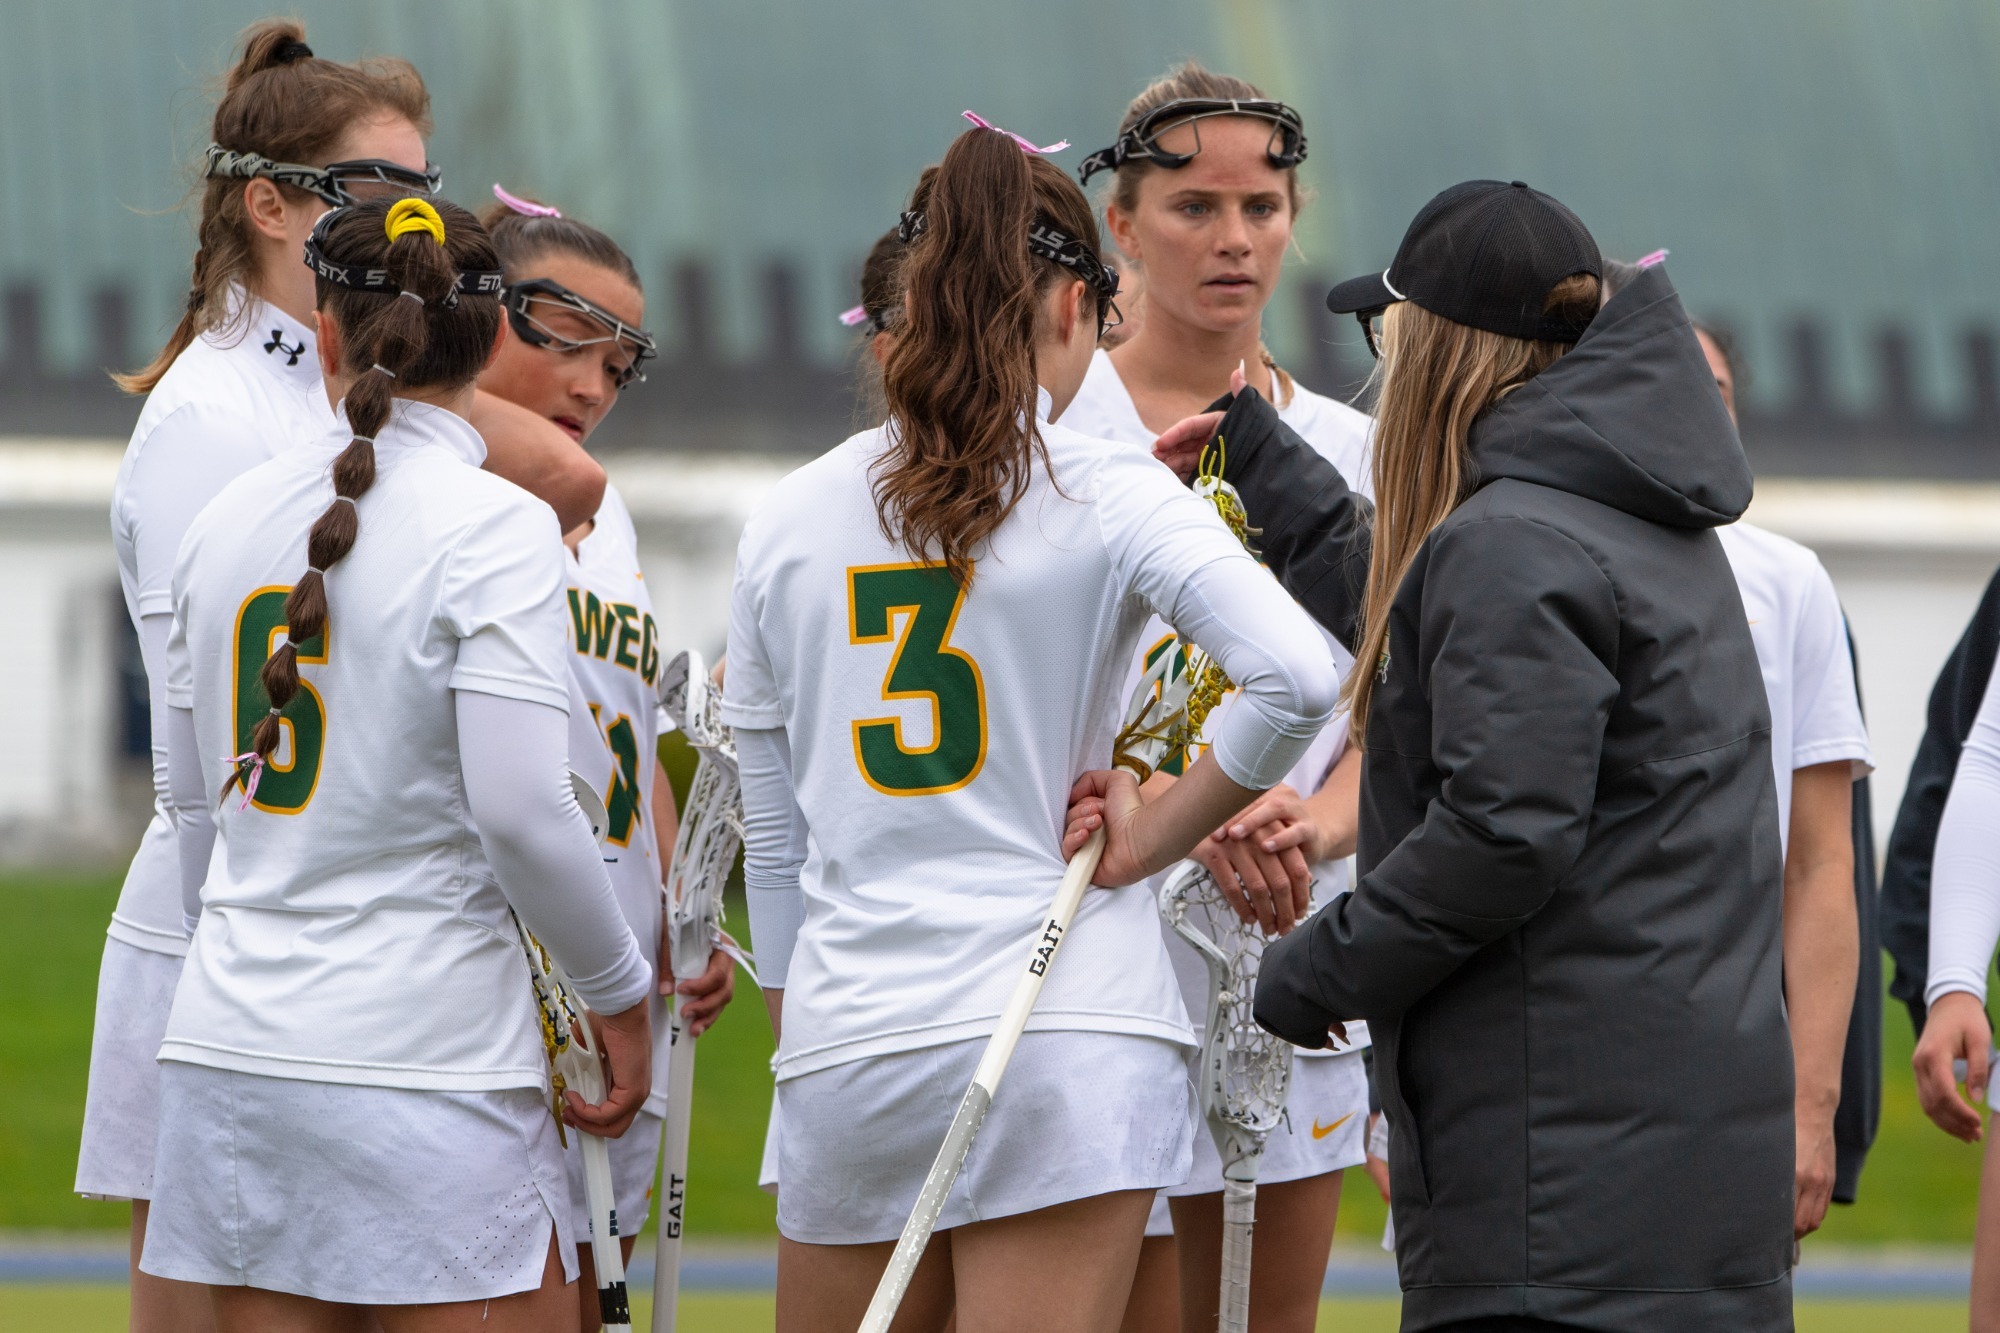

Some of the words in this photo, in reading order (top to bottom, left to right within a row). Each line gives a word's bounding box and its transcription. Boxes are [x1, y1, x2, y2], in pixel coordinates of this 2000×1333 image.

[318, 260, 350, 285] STX
[567, 588, 659, 688] WEG
[846, 558, 988, 797] 3
[232, 585, 330, 815] 6
[1028, 919, 1063, 978] GAIT
[667, 1173, 684, 1239] GAIT
